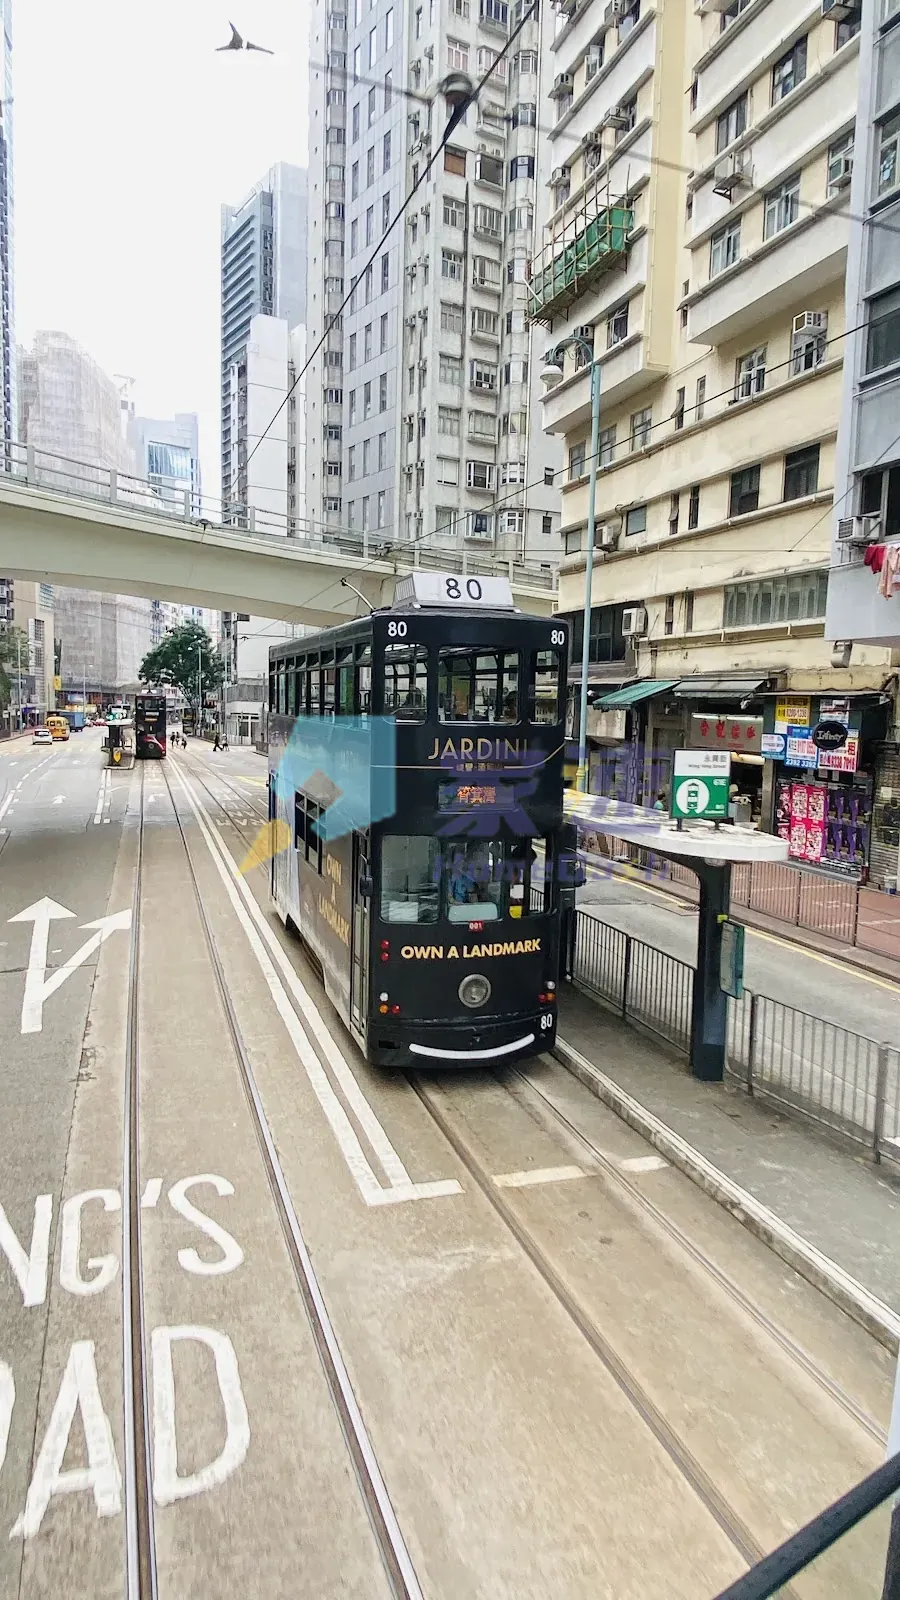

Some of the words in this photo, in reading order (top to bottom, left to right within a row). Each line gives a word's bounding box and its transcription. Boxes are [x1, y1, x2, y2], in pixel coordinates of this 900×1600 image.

[446, 578, 482, 600] 80
[387, 621, 408, 637] 80
[550, 630, 565, 645] 80
[327, 853, 341, 886] OWN
[331, 883, 336, 905] A
[400, 945, 444, 959] OWN
[447, 945, 459, 959] A
[463, 938, 541, 958] LANDMARK
[540, 1013, 553, 1030] 80
[0, 1324, 251, 1541] AD
